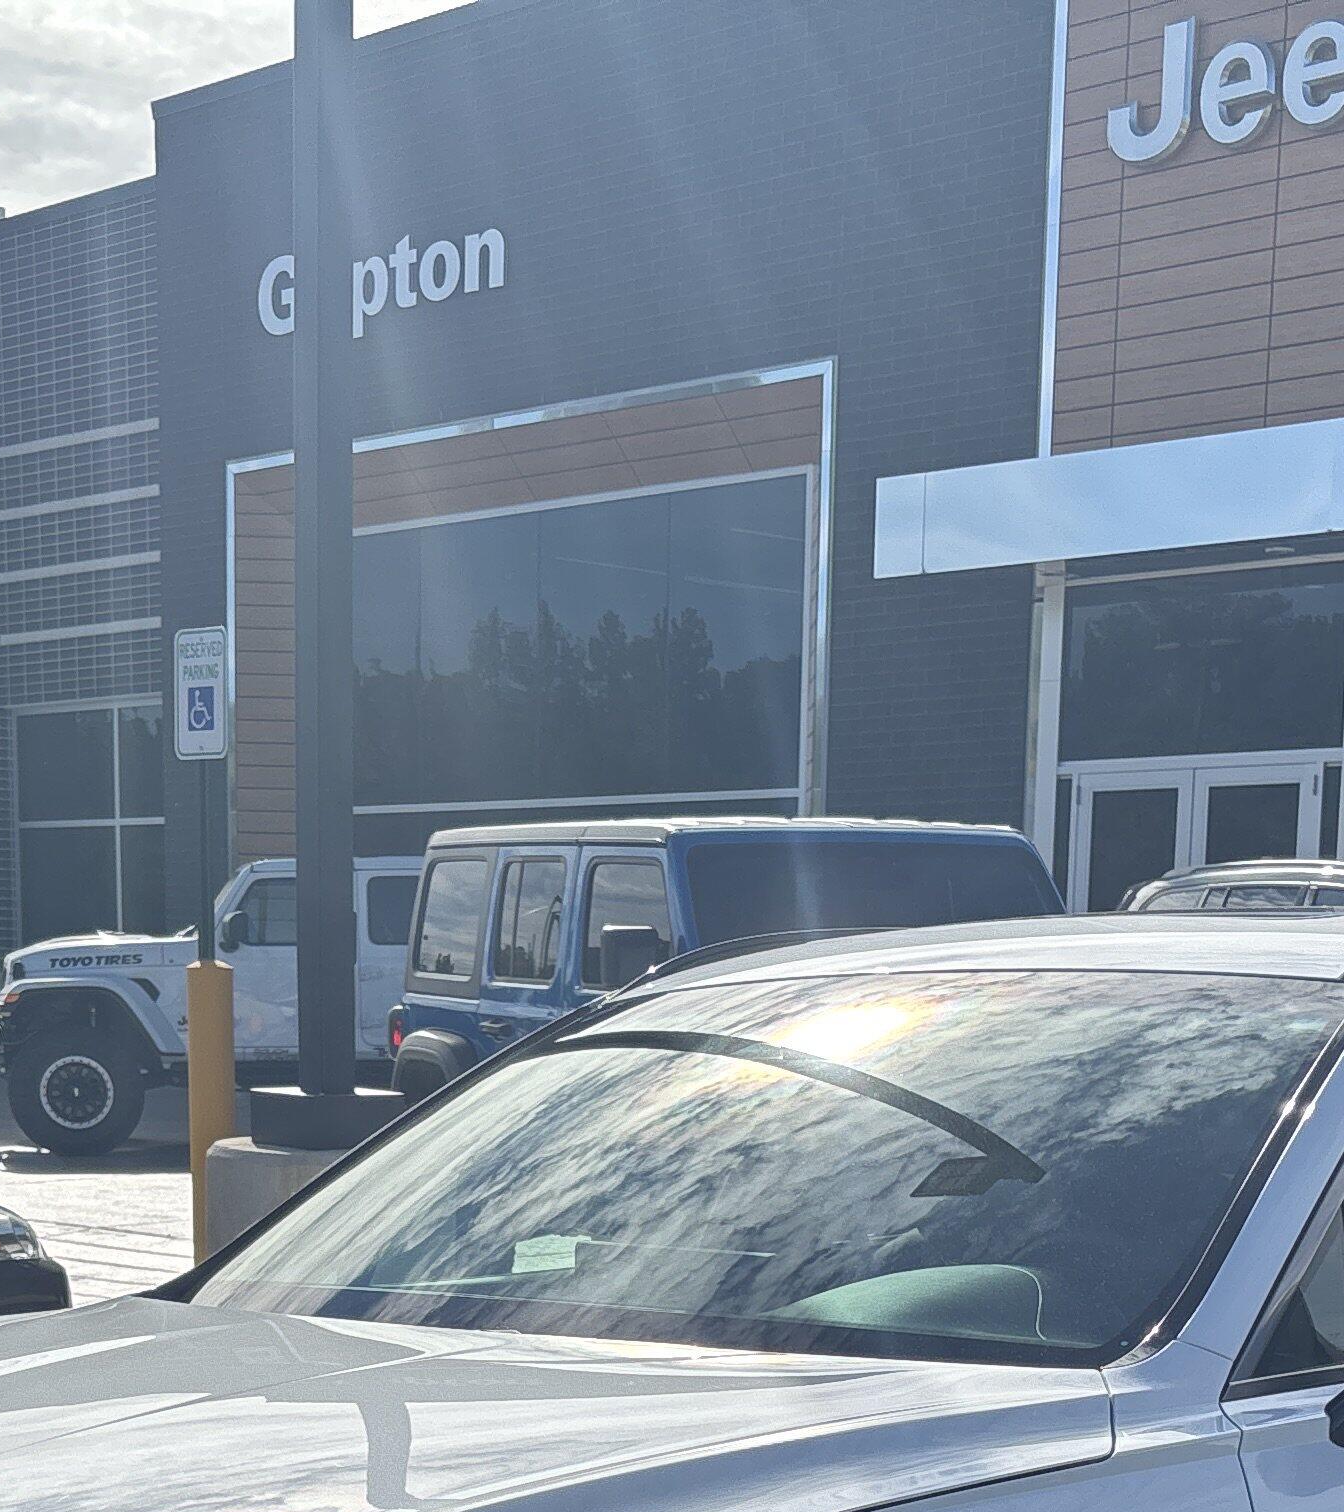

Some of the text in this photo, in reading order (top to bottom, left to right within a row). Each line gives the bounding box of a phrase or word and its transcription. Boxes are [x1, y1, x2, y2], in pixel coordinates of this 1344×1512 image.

[258, 228, 505, 338] Gpton
[179, 640, 223, 659] RESERVED
[183, 662, 219, 681] PARKING
[49, 953, 143, 968] TOYO TIRES
